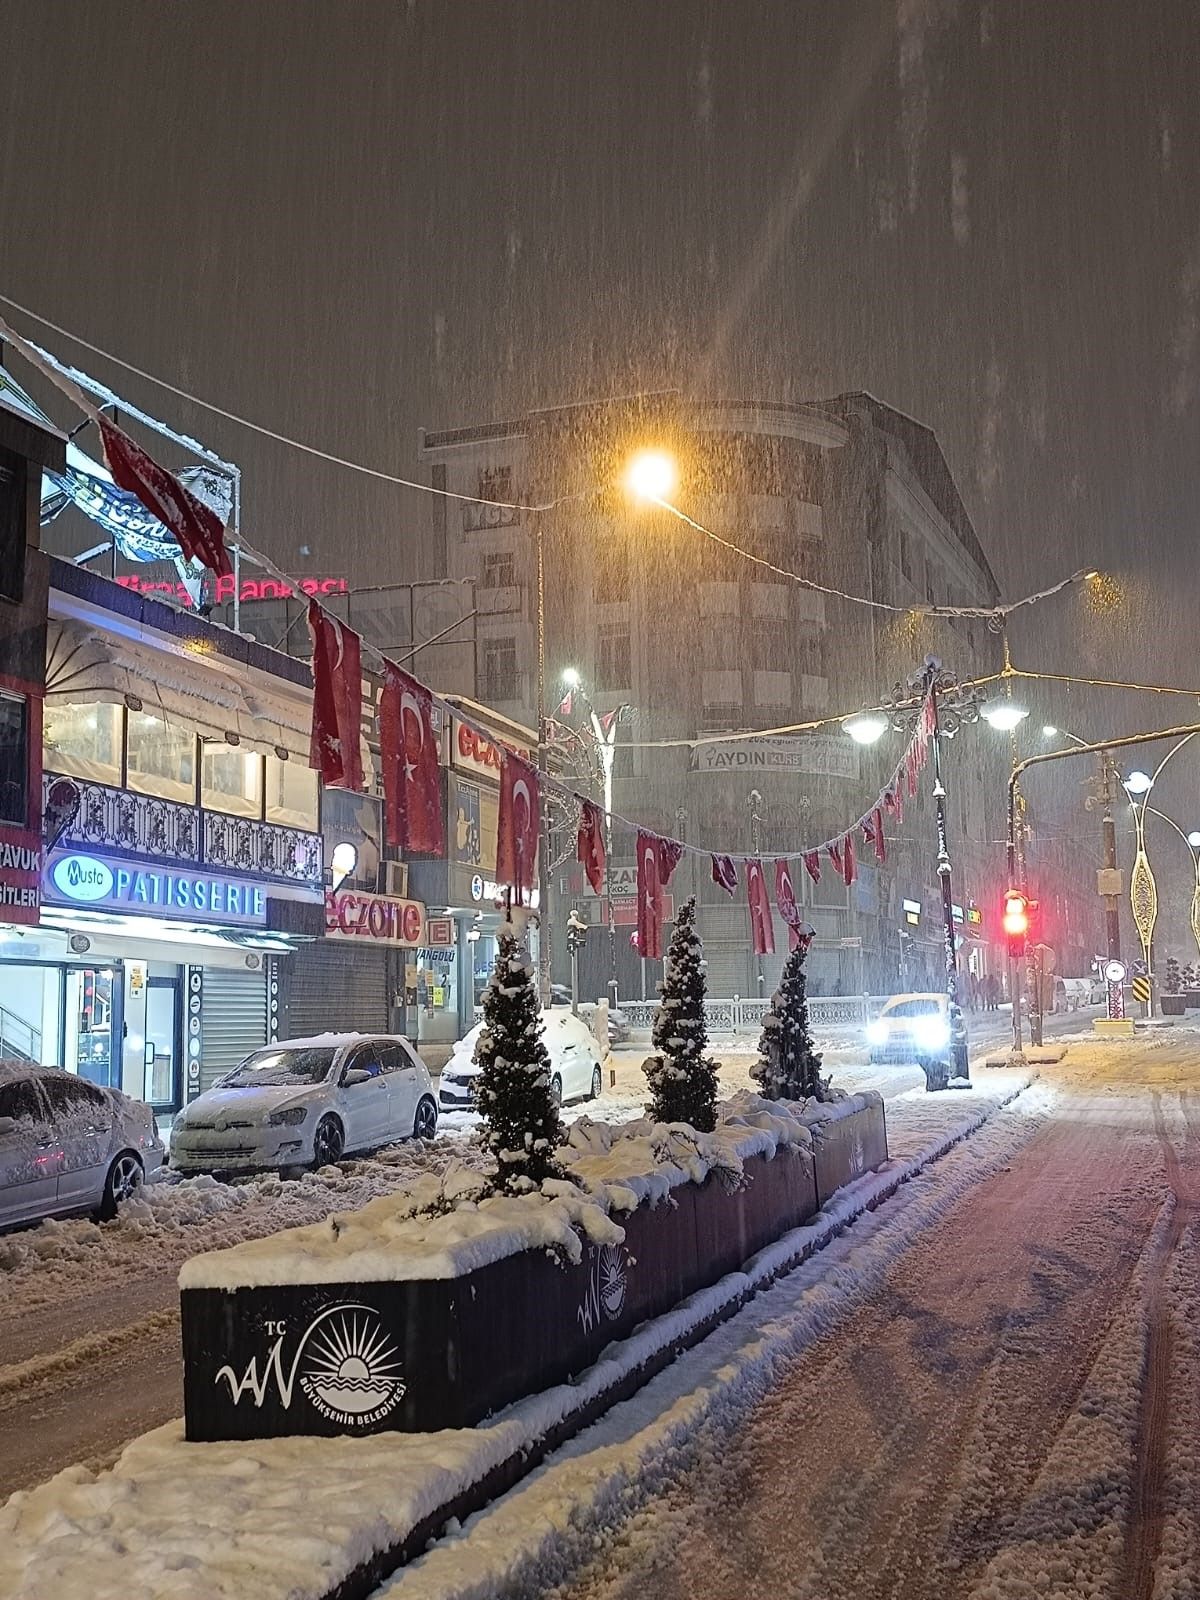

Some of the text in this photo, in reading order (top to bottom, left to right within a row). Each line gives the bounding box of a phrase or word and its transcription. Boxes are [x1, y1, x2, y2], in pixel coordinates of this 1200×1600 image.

[67, 860, 104, 885] Musta
[114, 868, 265, 915] PATISSERIE
[325, 891, 421, 941] eczane
[264, 1320, 287, 1336] TC
[300, 1376, 407, 1426] BÜYÜKŞEHİR BELEDİYESİ
